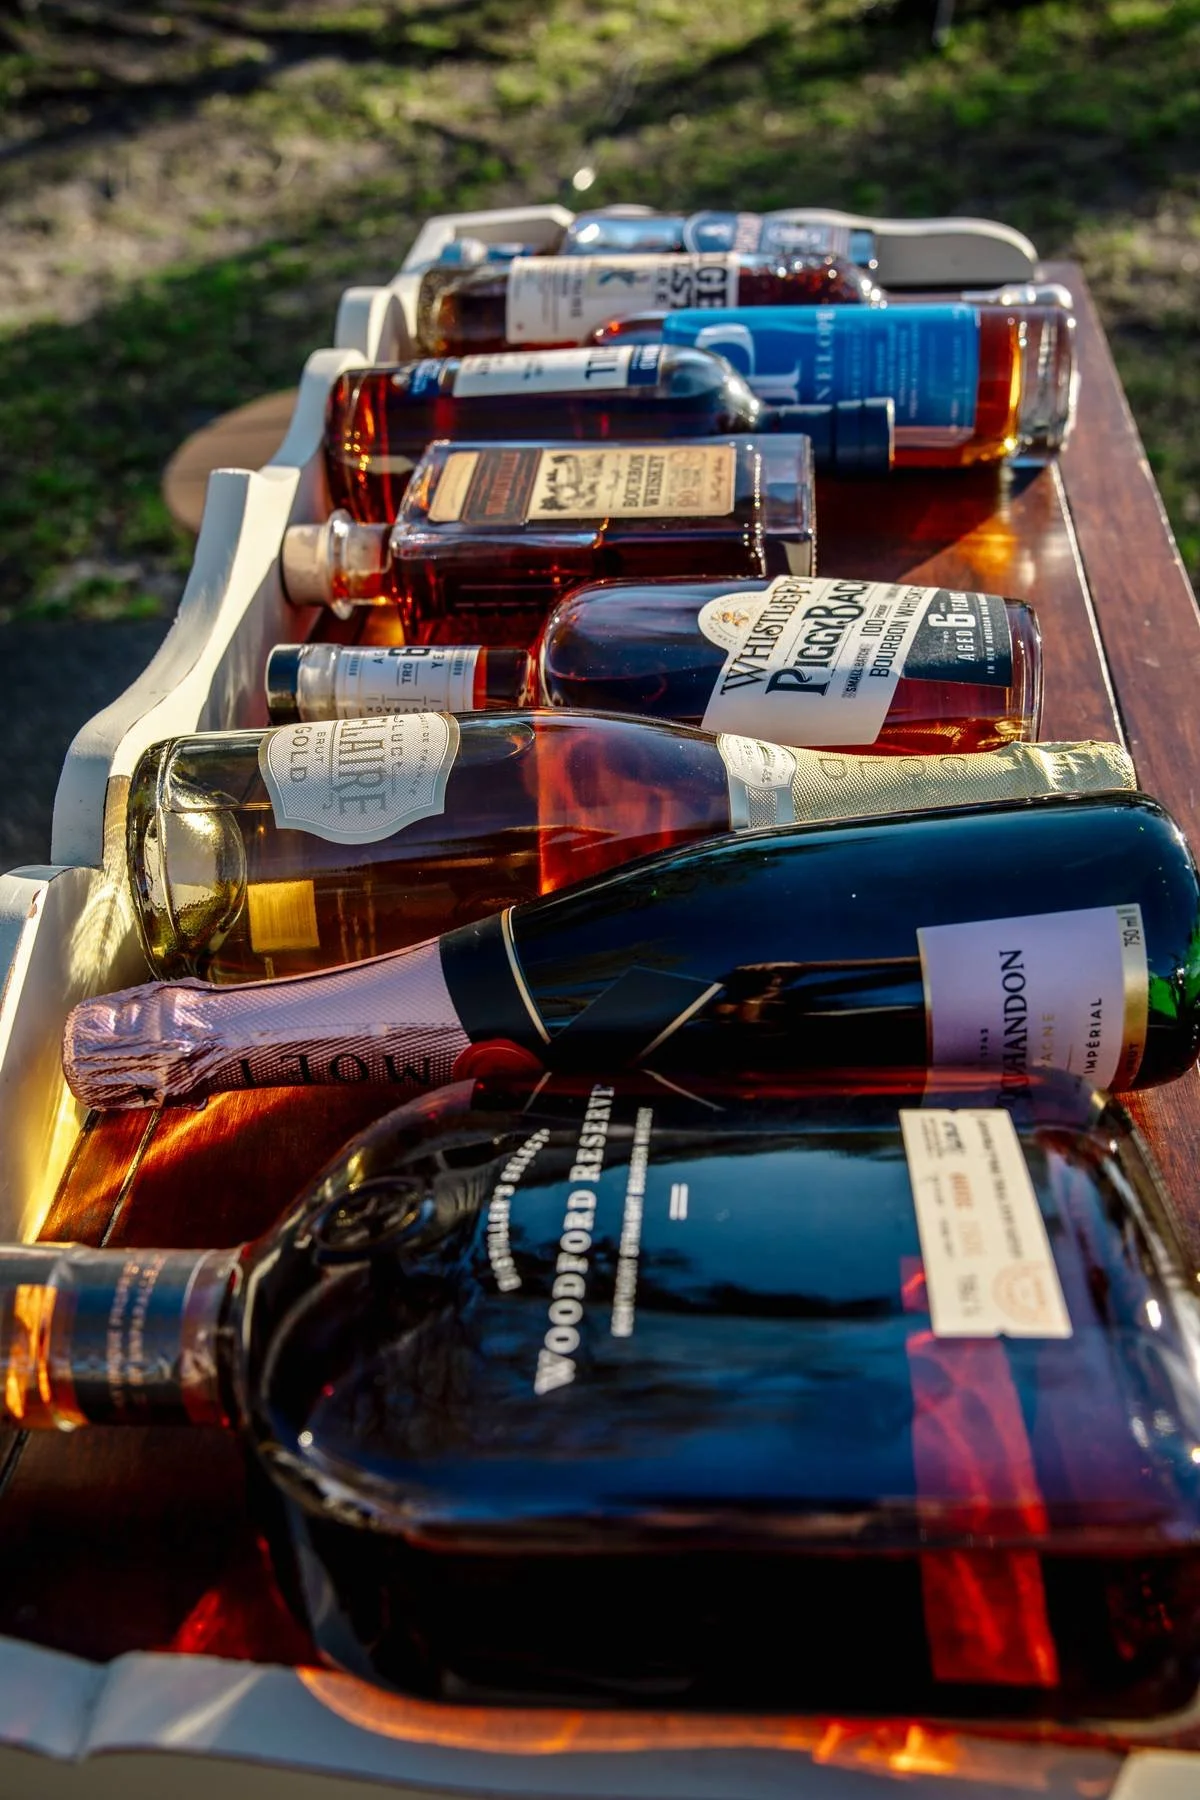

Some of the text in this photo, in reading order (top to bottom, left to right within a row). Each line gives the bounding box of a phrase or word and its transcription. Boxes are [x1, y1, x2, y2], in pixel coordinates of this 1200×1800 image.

[815, 309, 836, 401] NELOPE
[623, 454, 645, 508] BOURBON
[643, 454, 665, 507] WHISKEY
[720, 576, 813, 696] WHISTLEPI
[765, 580, 869, 696] PIGGYBAC
[860, 619, 886, 637] 100
[869, 587, 928, 678] BOURBON WHISKE
[928, 613, 976, 627] 6
[956, 630, 975, 661] AGED
[846, 665, 863, 692] SMALL
[289, 726, 313, 783] GOLD
[315, 731, 327, 763] BRUT
[332, 718, 387, 815] ELAIRE
[1122, 915, 1138, 928] ml
[1123, 929, 1141, 948] 750
[999, 949, 1029, 1075] HANDON
[1084, 998, 1102, 1074] IMPÉRIAL
[534, 1189, 598, 1396] WOODFORD
